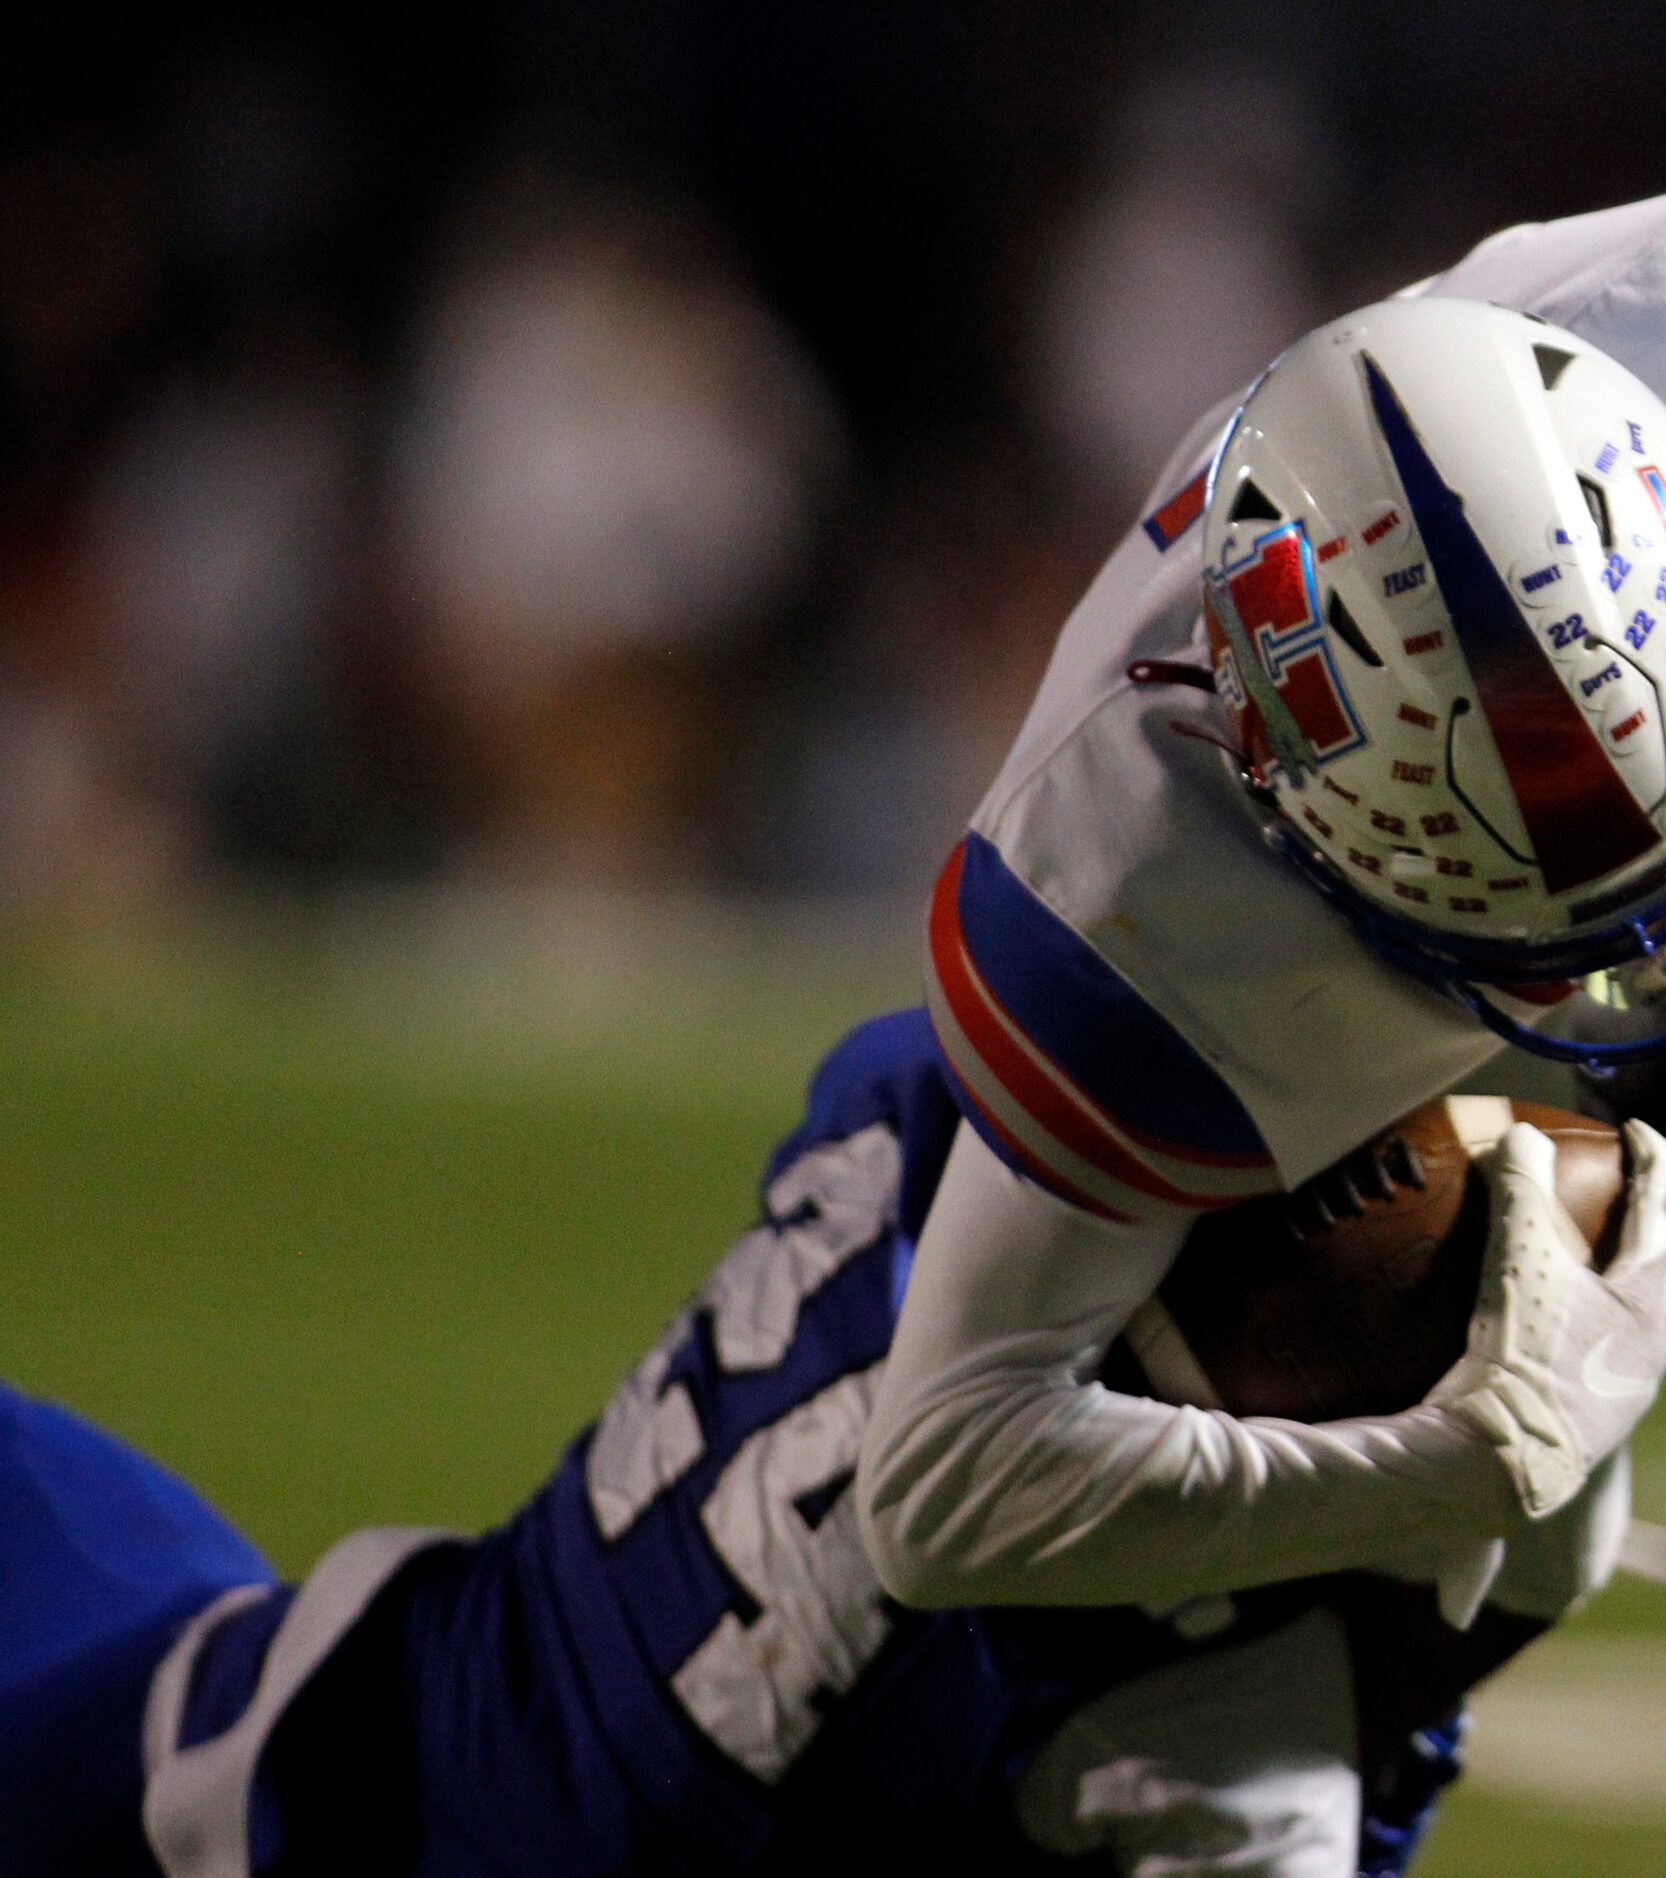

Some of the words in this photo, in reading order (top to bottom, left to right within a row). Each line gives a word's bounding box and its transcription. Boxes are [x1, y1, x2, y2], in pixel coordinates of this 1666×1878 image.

[1602, 553, 1632, 593] 22
[1547, 613, 1588, 649] 22
[1624, 609, 1656, 650] 22
[1370, 809, 1406, 836] 22
[1420, 812, 1460, 837] 22
[1436, 857, 1474, 878] 22
[1394, 882, 1429, 904] 22
[1450, 896, 1489, 912] 22
